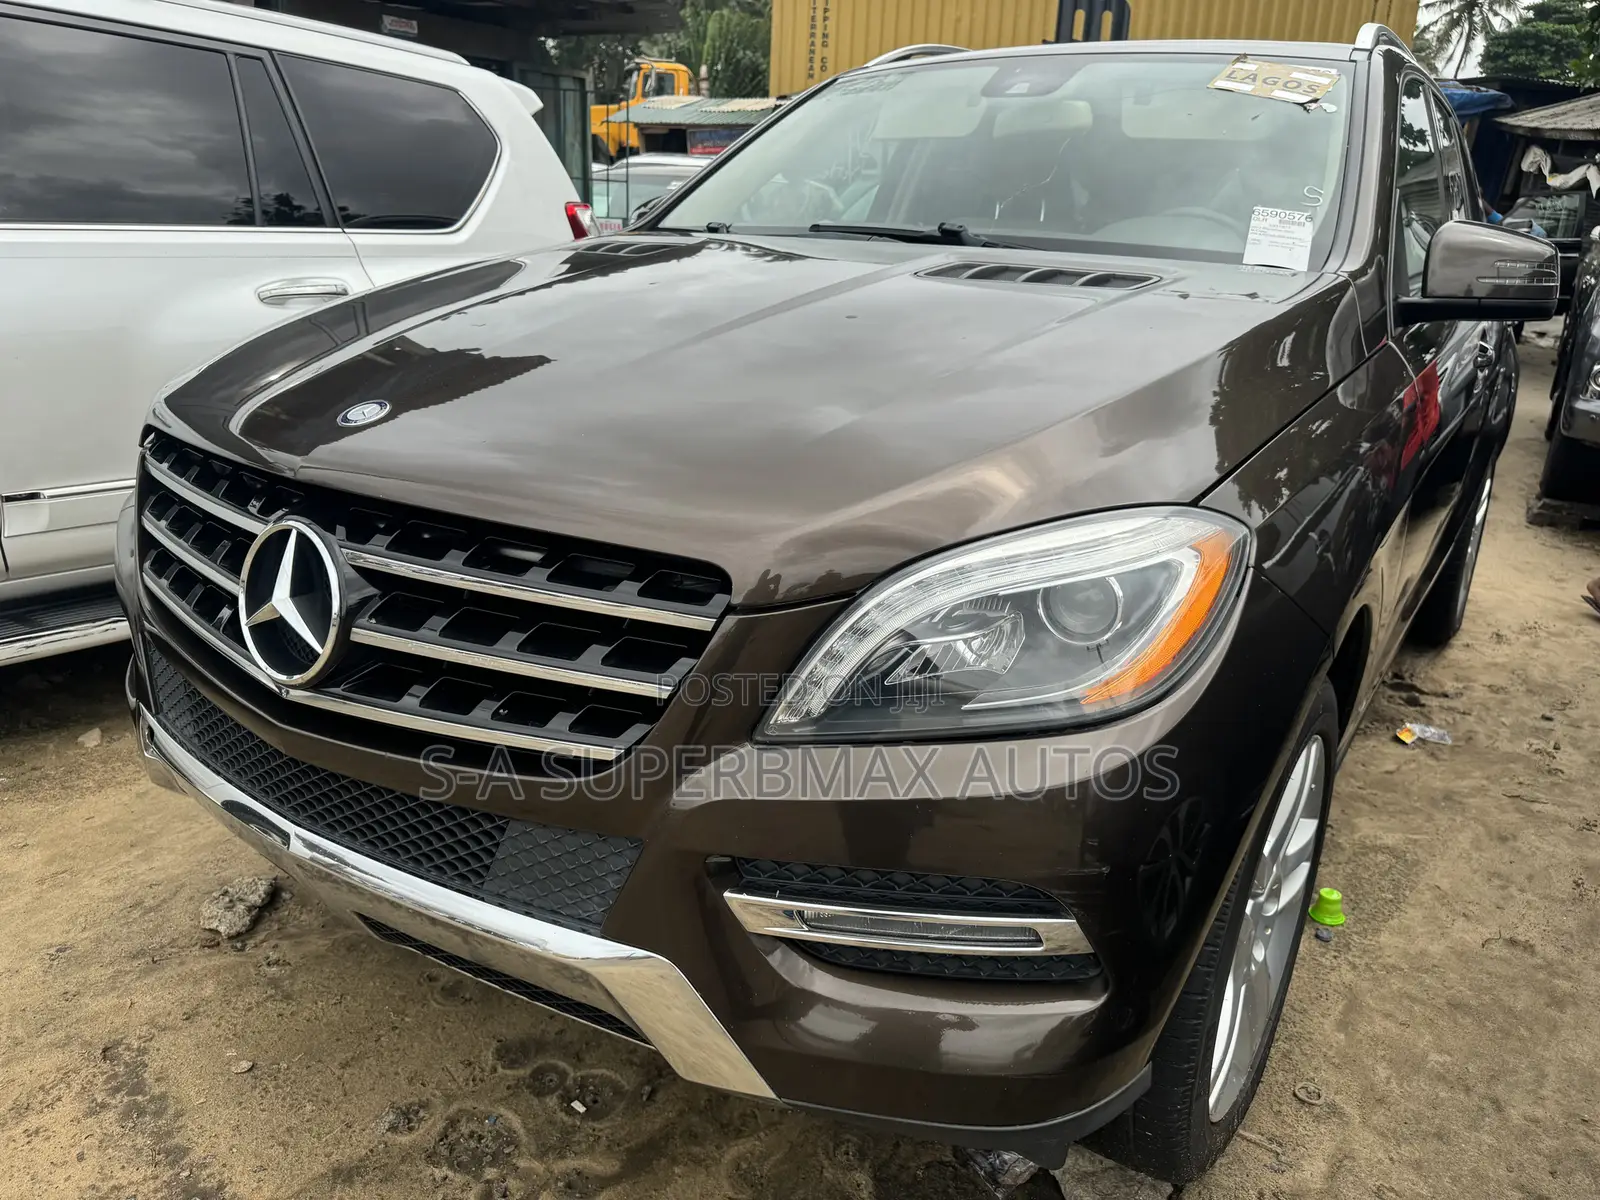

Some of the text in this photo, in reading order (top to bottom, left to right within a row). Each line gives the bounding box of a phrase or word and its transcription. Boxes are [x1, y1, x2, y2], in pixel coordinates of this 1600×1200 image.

[821, 57, 828, 72] CO
[1225, 70, 1320, 94] LAGOS
[1300, 185, 1324, 207] S
[1252, 208, 1314, 222] 6590576
